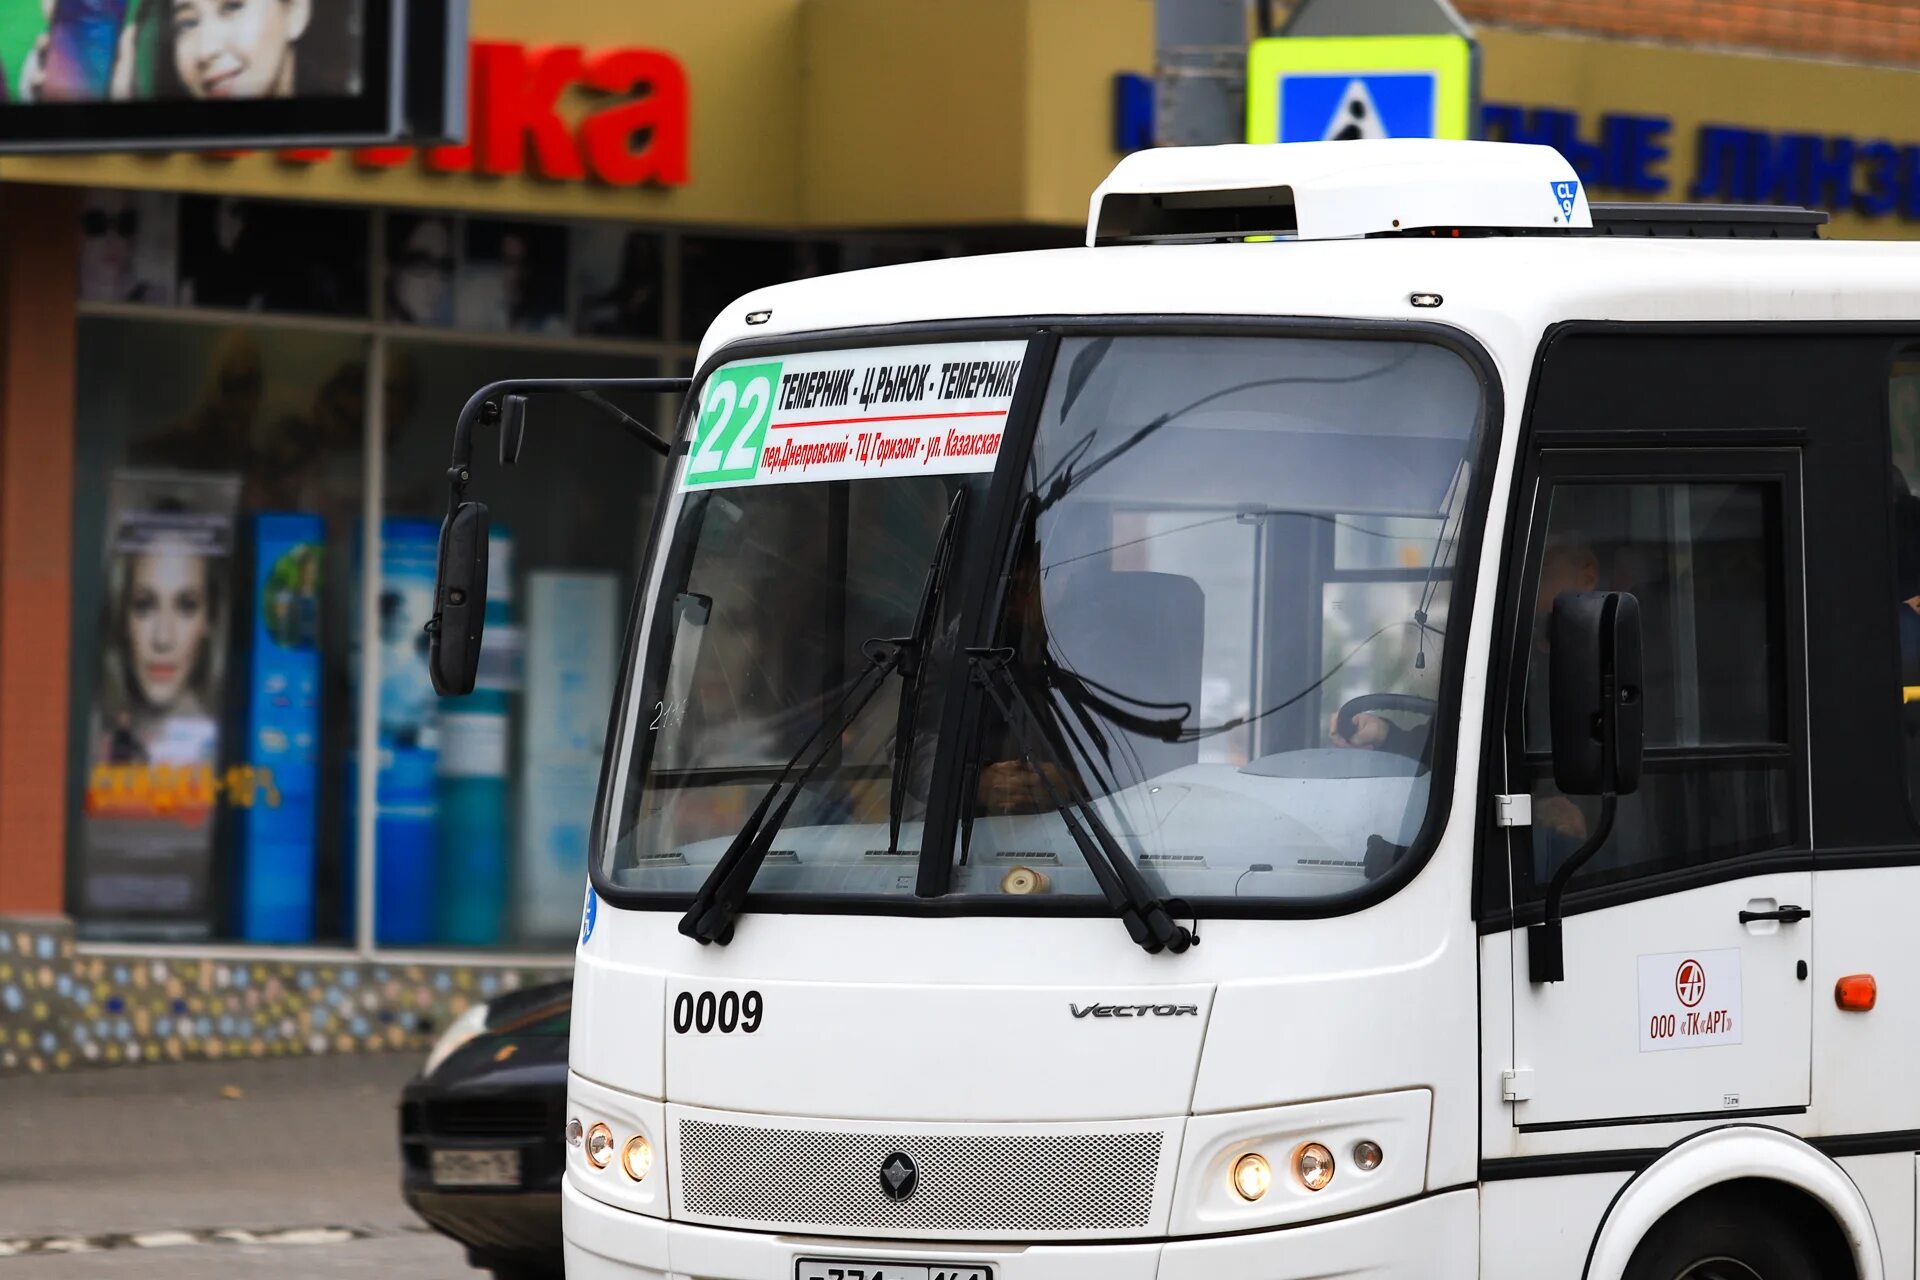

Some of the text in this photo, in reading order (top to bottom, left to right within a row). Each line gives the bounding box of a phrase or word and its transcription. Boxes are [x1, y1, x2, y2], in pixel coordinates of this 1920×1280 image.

[1557, 183, 1574, 199] CL
[1562, 199, 1572, 217] 9
[779, 369, 855, 410] ТЕМЕРНИК
[859, 364, 931, 412] Ц.РЫНОК
[937, 360, 1021, 400] ТЕМЕРНИК
[689, 376, 771, 474] 22
[855, 432, 873, 467] ТЦ
[870, 432, 921, 467] Горизонт
[923, 436, 941, 466] ул.
[943, 428, 1001, 457] Казахская
[673, 990, 764, 1034] 0009
[1069, 1002, 1198, 1019] VECTOR
[1650, 1014, 1676, 1039] ООО
